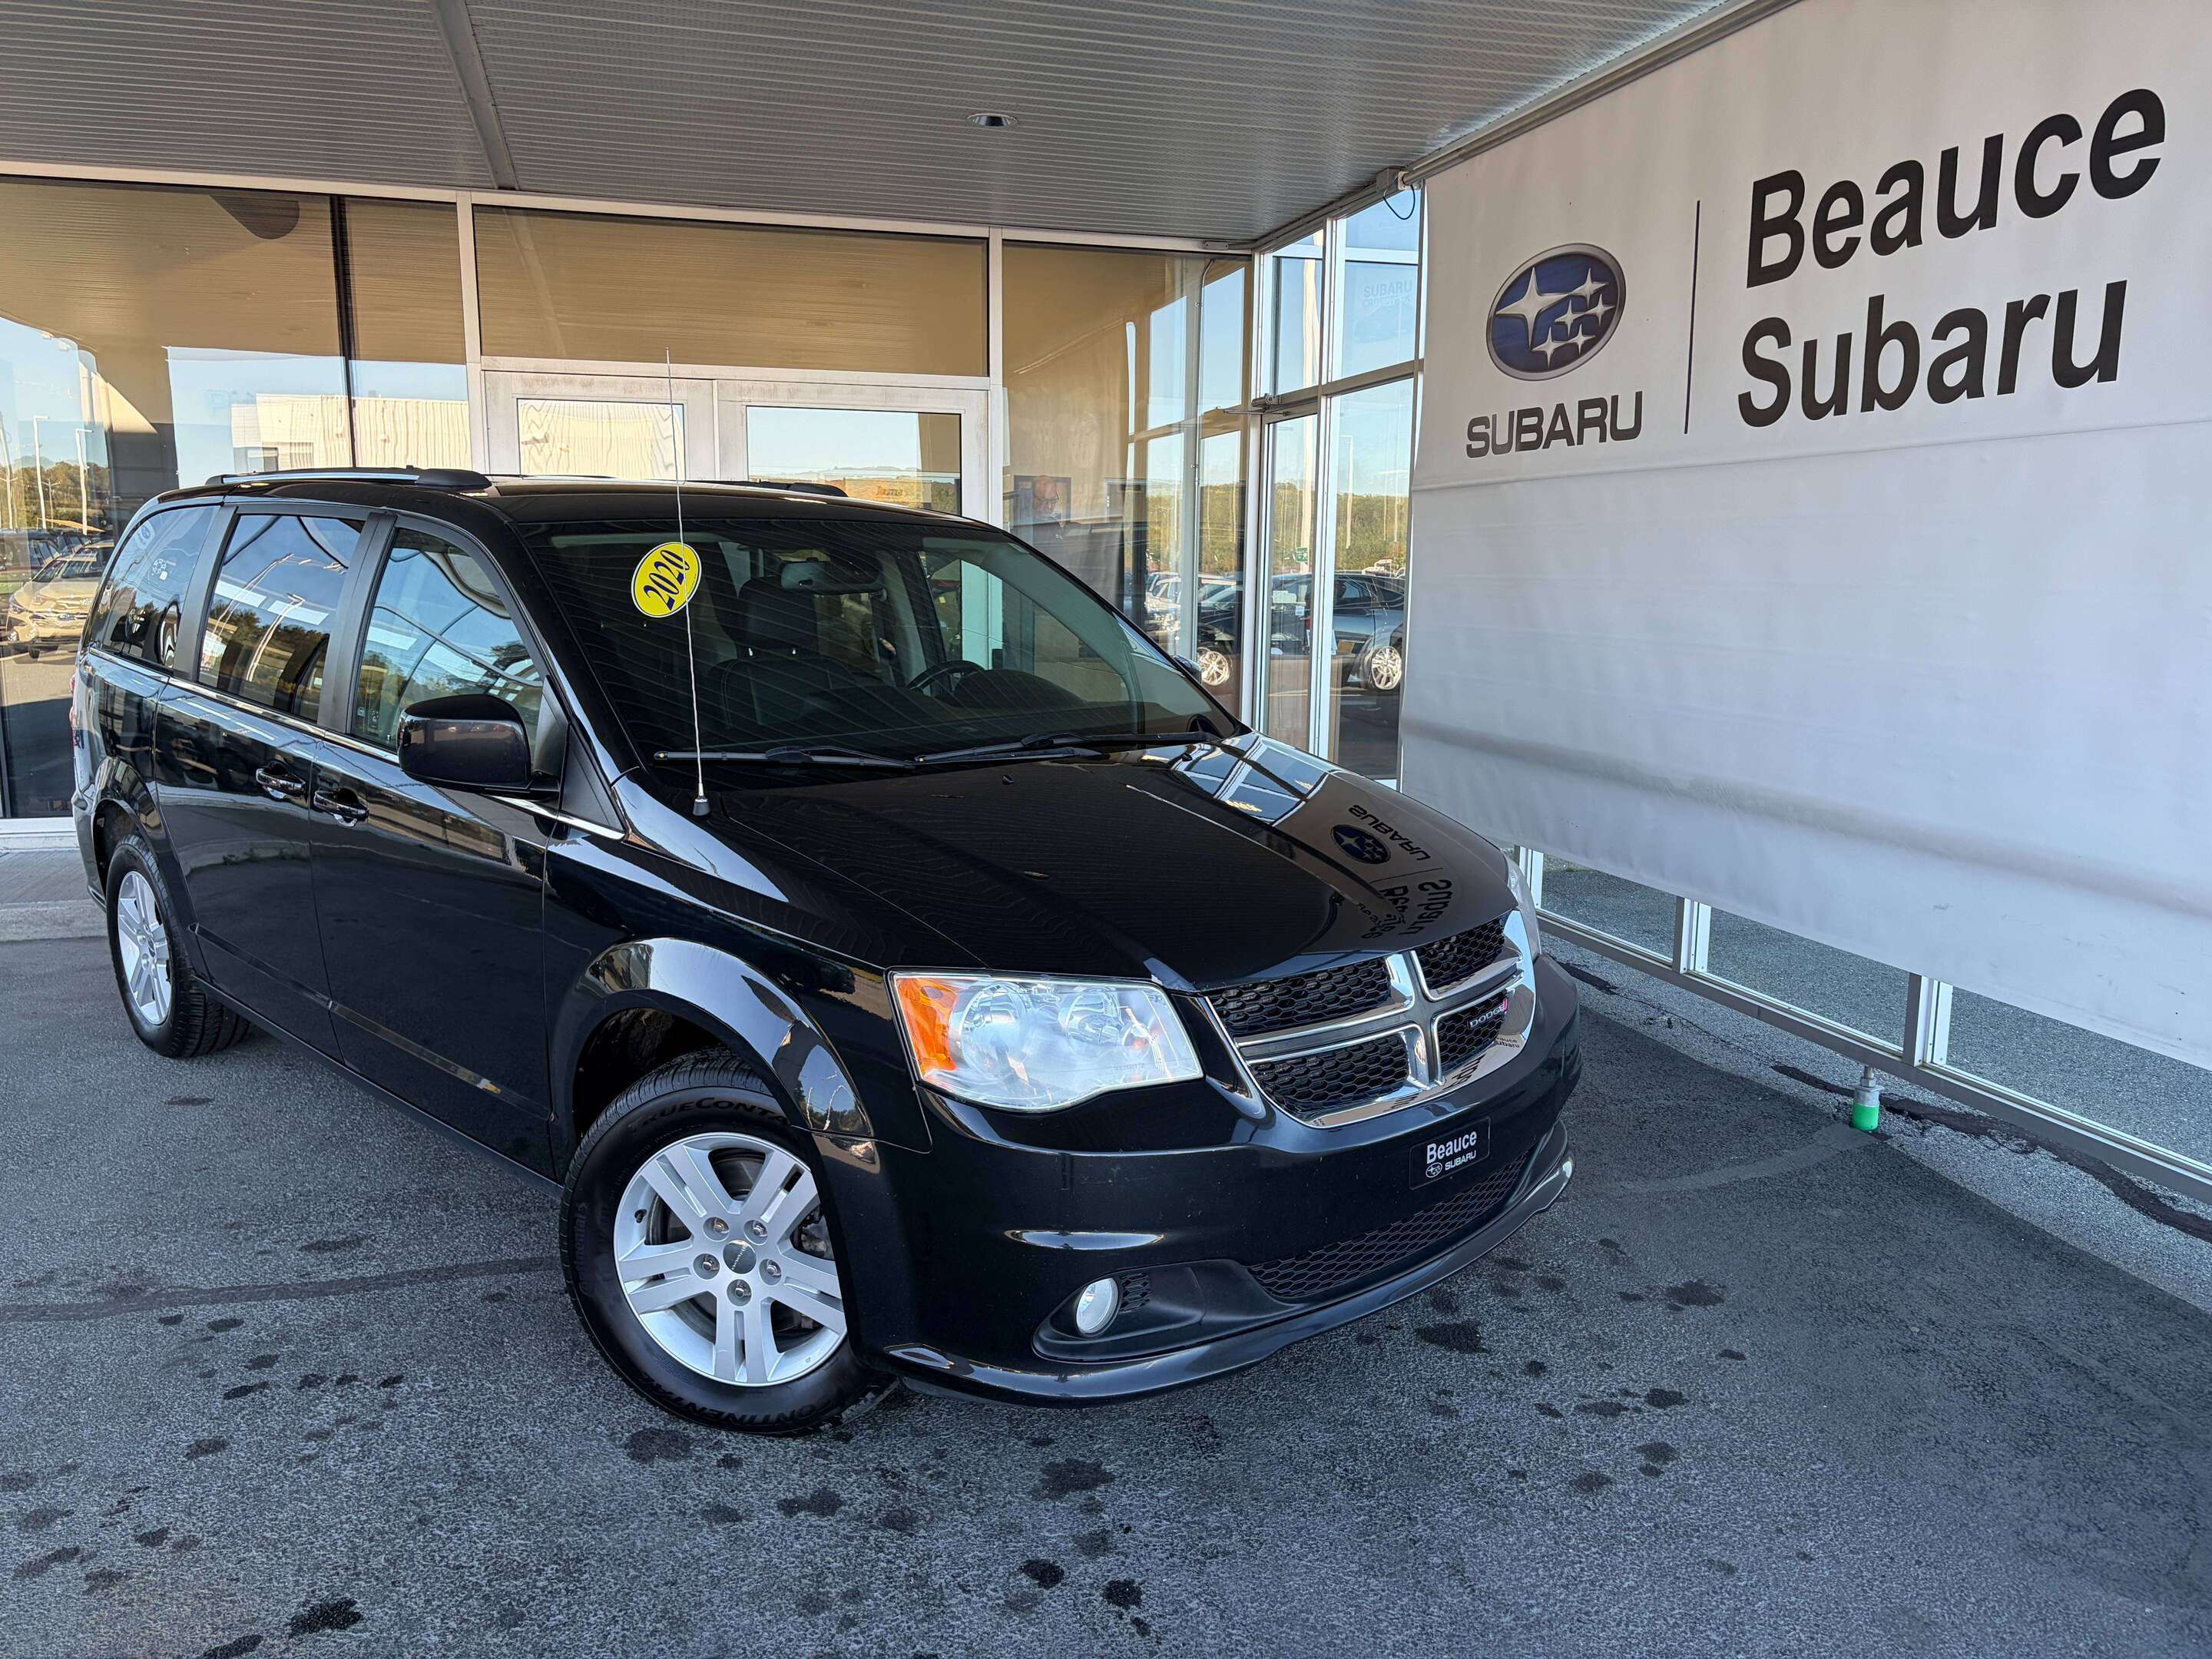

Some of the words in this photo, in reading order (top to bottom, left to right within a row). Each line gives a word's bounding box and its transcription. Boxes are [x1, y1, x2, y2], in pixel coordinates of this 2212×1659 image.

[1746, 88, 2167, 290] Beauce
[1363, 279, 1412, 298] SUBARU
[1737, 279, 2128, 428] Subaru
[1465, 390, 1643, 459] SUBARU
[643, 549, 690, 611] 2020
[1469, 1002, 1505, 1028] DODGE
[628, 1097, 788, 1133] TRUECONTA
[1426, 1131, 1477, 1164] Beauce
[1445, 1150, 1476, 1171] SUBARU
